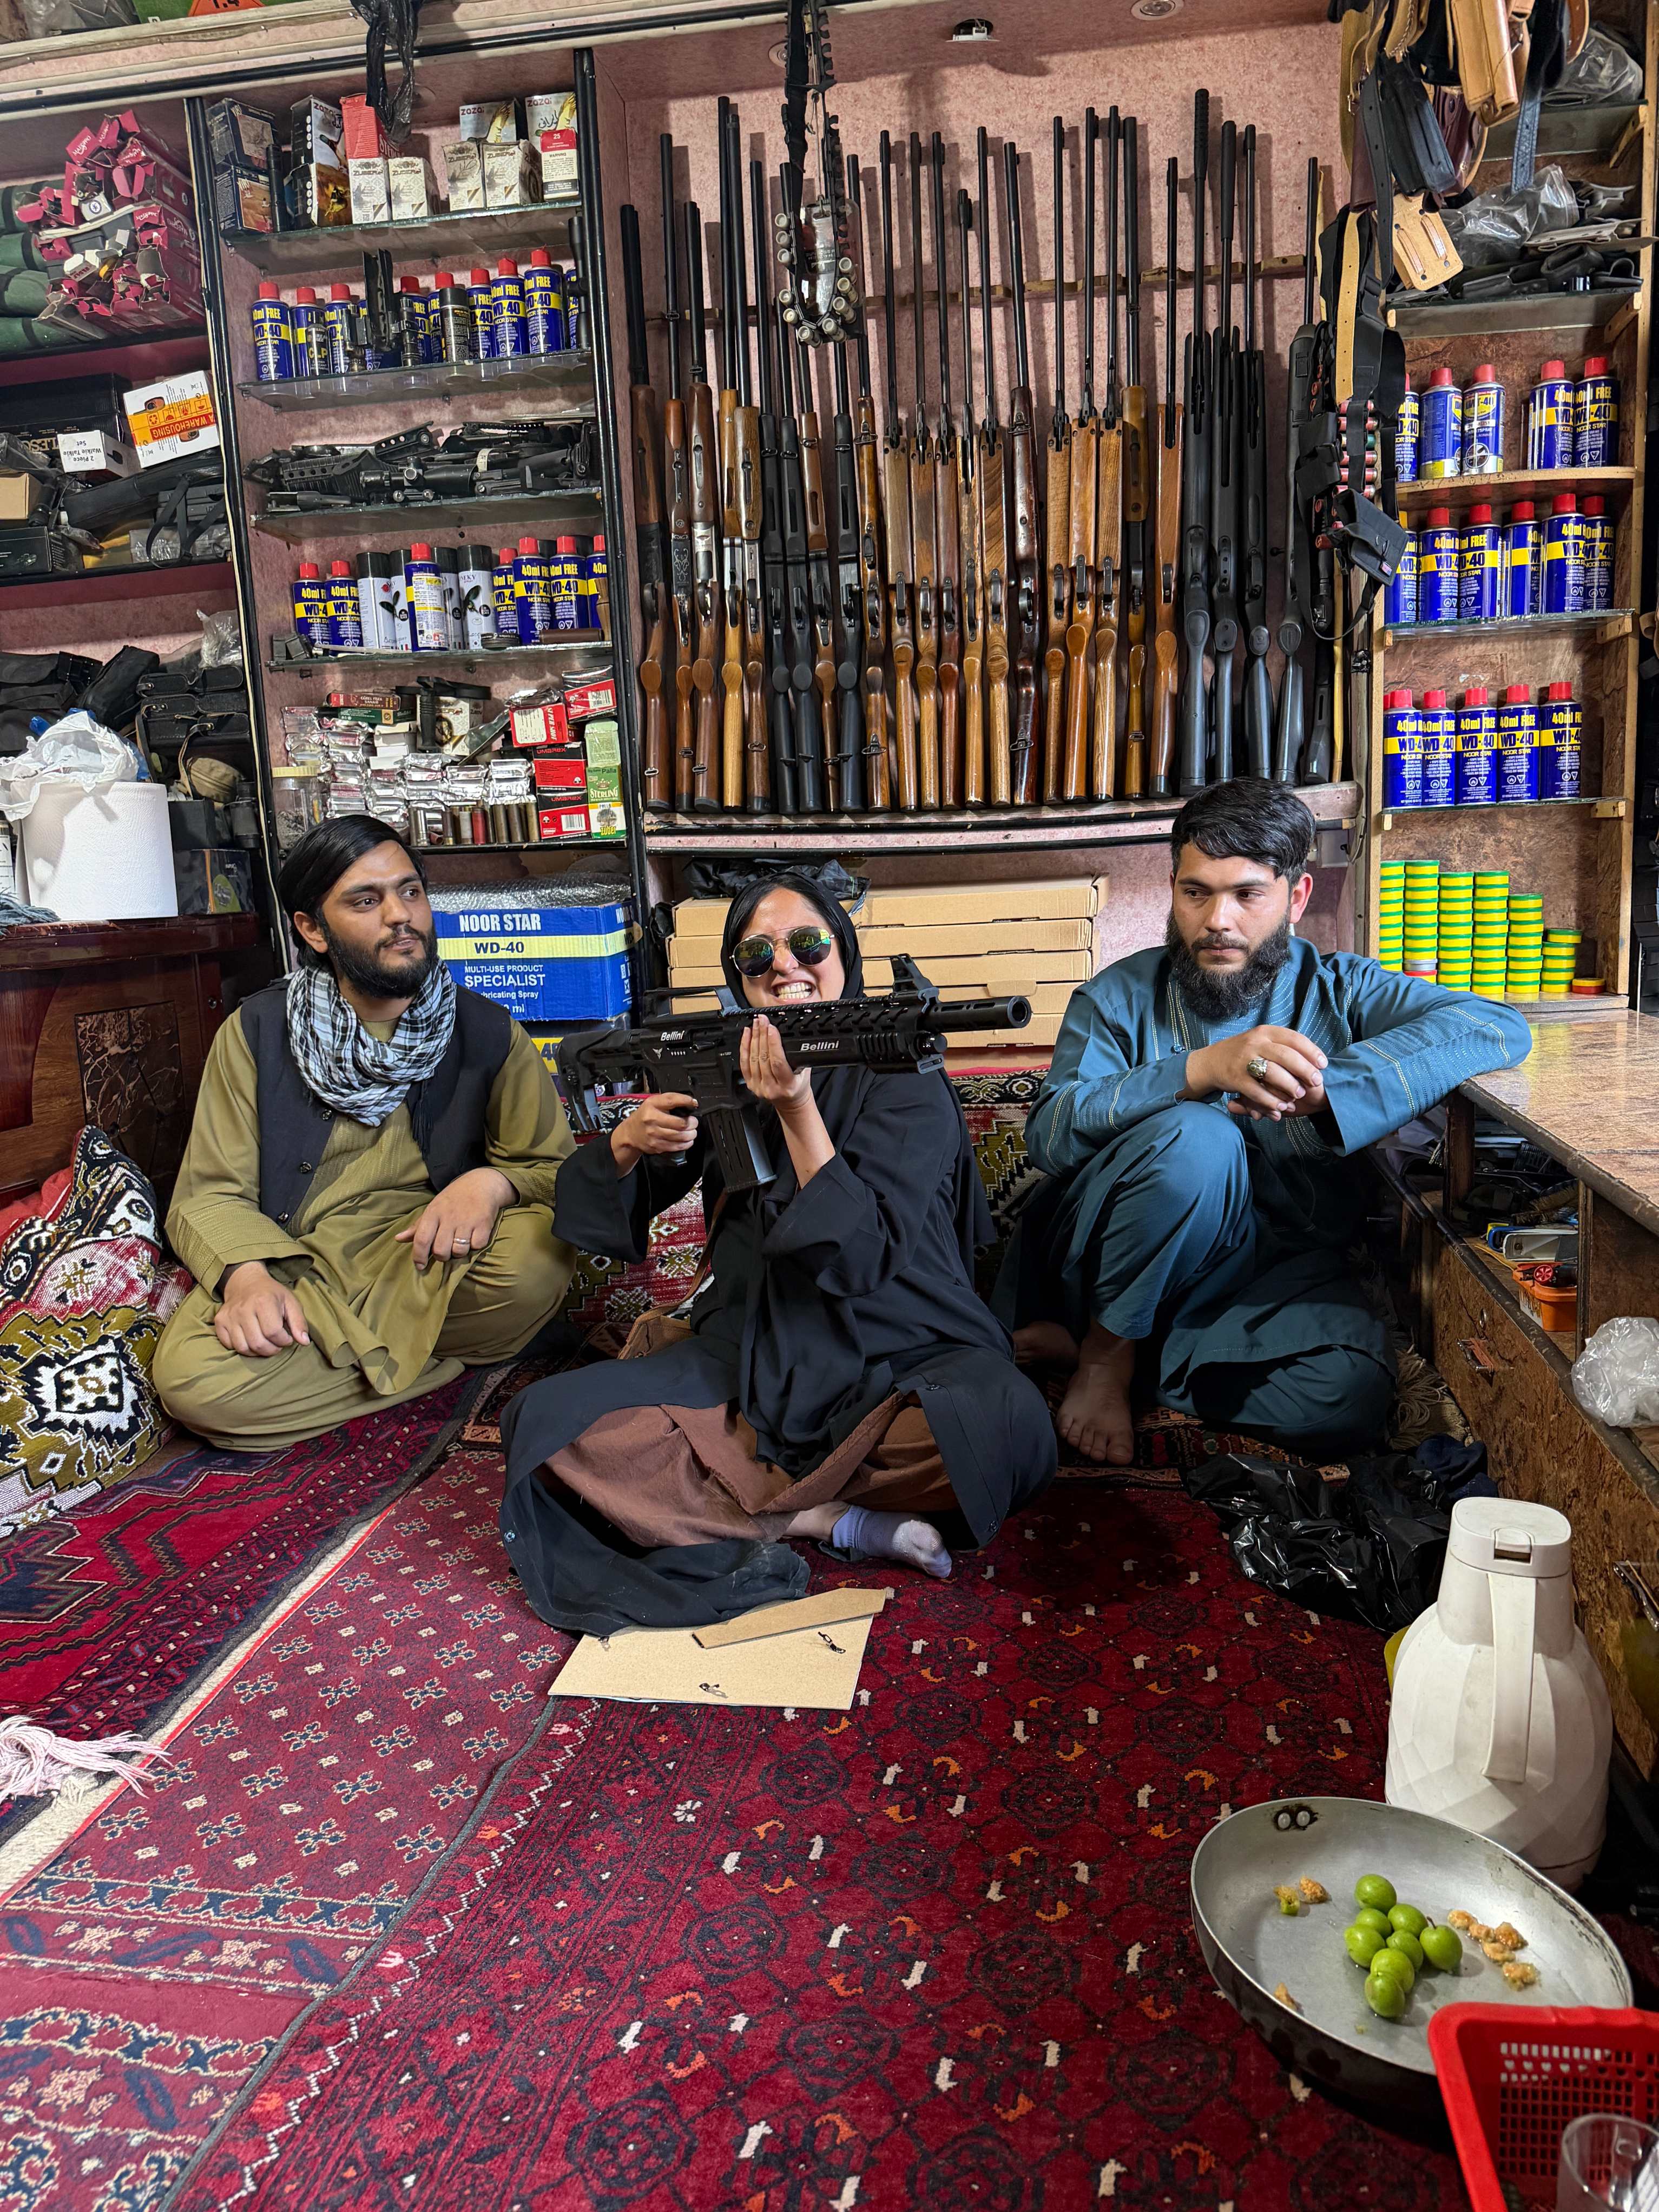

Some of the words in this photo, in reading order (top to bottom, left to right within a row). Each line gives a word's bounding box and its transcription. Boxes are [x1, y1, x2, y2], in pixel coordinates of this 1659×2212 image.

[536, 276, 551, 288] FREE
[505, 285, 520, 297] FREE
[267, 307, 281, 320] FREE
[1596, 387, 1611, 399] FREE
[153, 417, 207, 438] WAREHOUSING
[1562, 523, 1582, 536] 40ml
[1434, 536, 1454, 549] 40ml
[1471, 535, 1487, 547] FREE
[1436, 554, 1458, 569] WD-4
[1461, 552, 1485, 569] D-40
[522, 564, 540, 576] 40ml
[564, 564, 578, 575] FREE
[302, 588, 320, 598] 40ml
[331, 586, 348, 597] 40ml
[551, 580, 579, 594] WD-40
[495, 591, 514, 604] WD-4
[304, 603, 326, 616] WD-4
[1460, 718, 1480, 730] 40ml
[1483, 717, 1496, 729] FREE
[1500, 715, 1519, 728] 40ml
[1521, 715, 1536, 727] FREE
[1552, 712, 1574, 725] 40ml
[1397, 720, 1417, 732] 40ml
[1444, 720, 1455, 732] FREE
[1398, 737, 1421, 752] WD-4
[1462, 734, 1495, 750] WD-40
[1500, 732, 1534, 748] WD-40
[590, 786, 618, 799] STERLING
[600, 826, 616, 835] zuber
[459, 913, 501, 932] NOOR
[503, 913, 542, 932] STAR
[474, 941, 525, 954] WD-40
[465, 965, 505, 973] MULTI-USE
[507, 964, 544, 972] PRODUCT
[464, 973, 546, 988] SPECIALIST
[480, 991, 516, 999] bricating
[518, 990, 539, 999] Spray
[512, 1003, 524, 1013] ml
[660, 1030, 686, 1042] Bellini
[800, 1040, 839, 1051] Bellini
